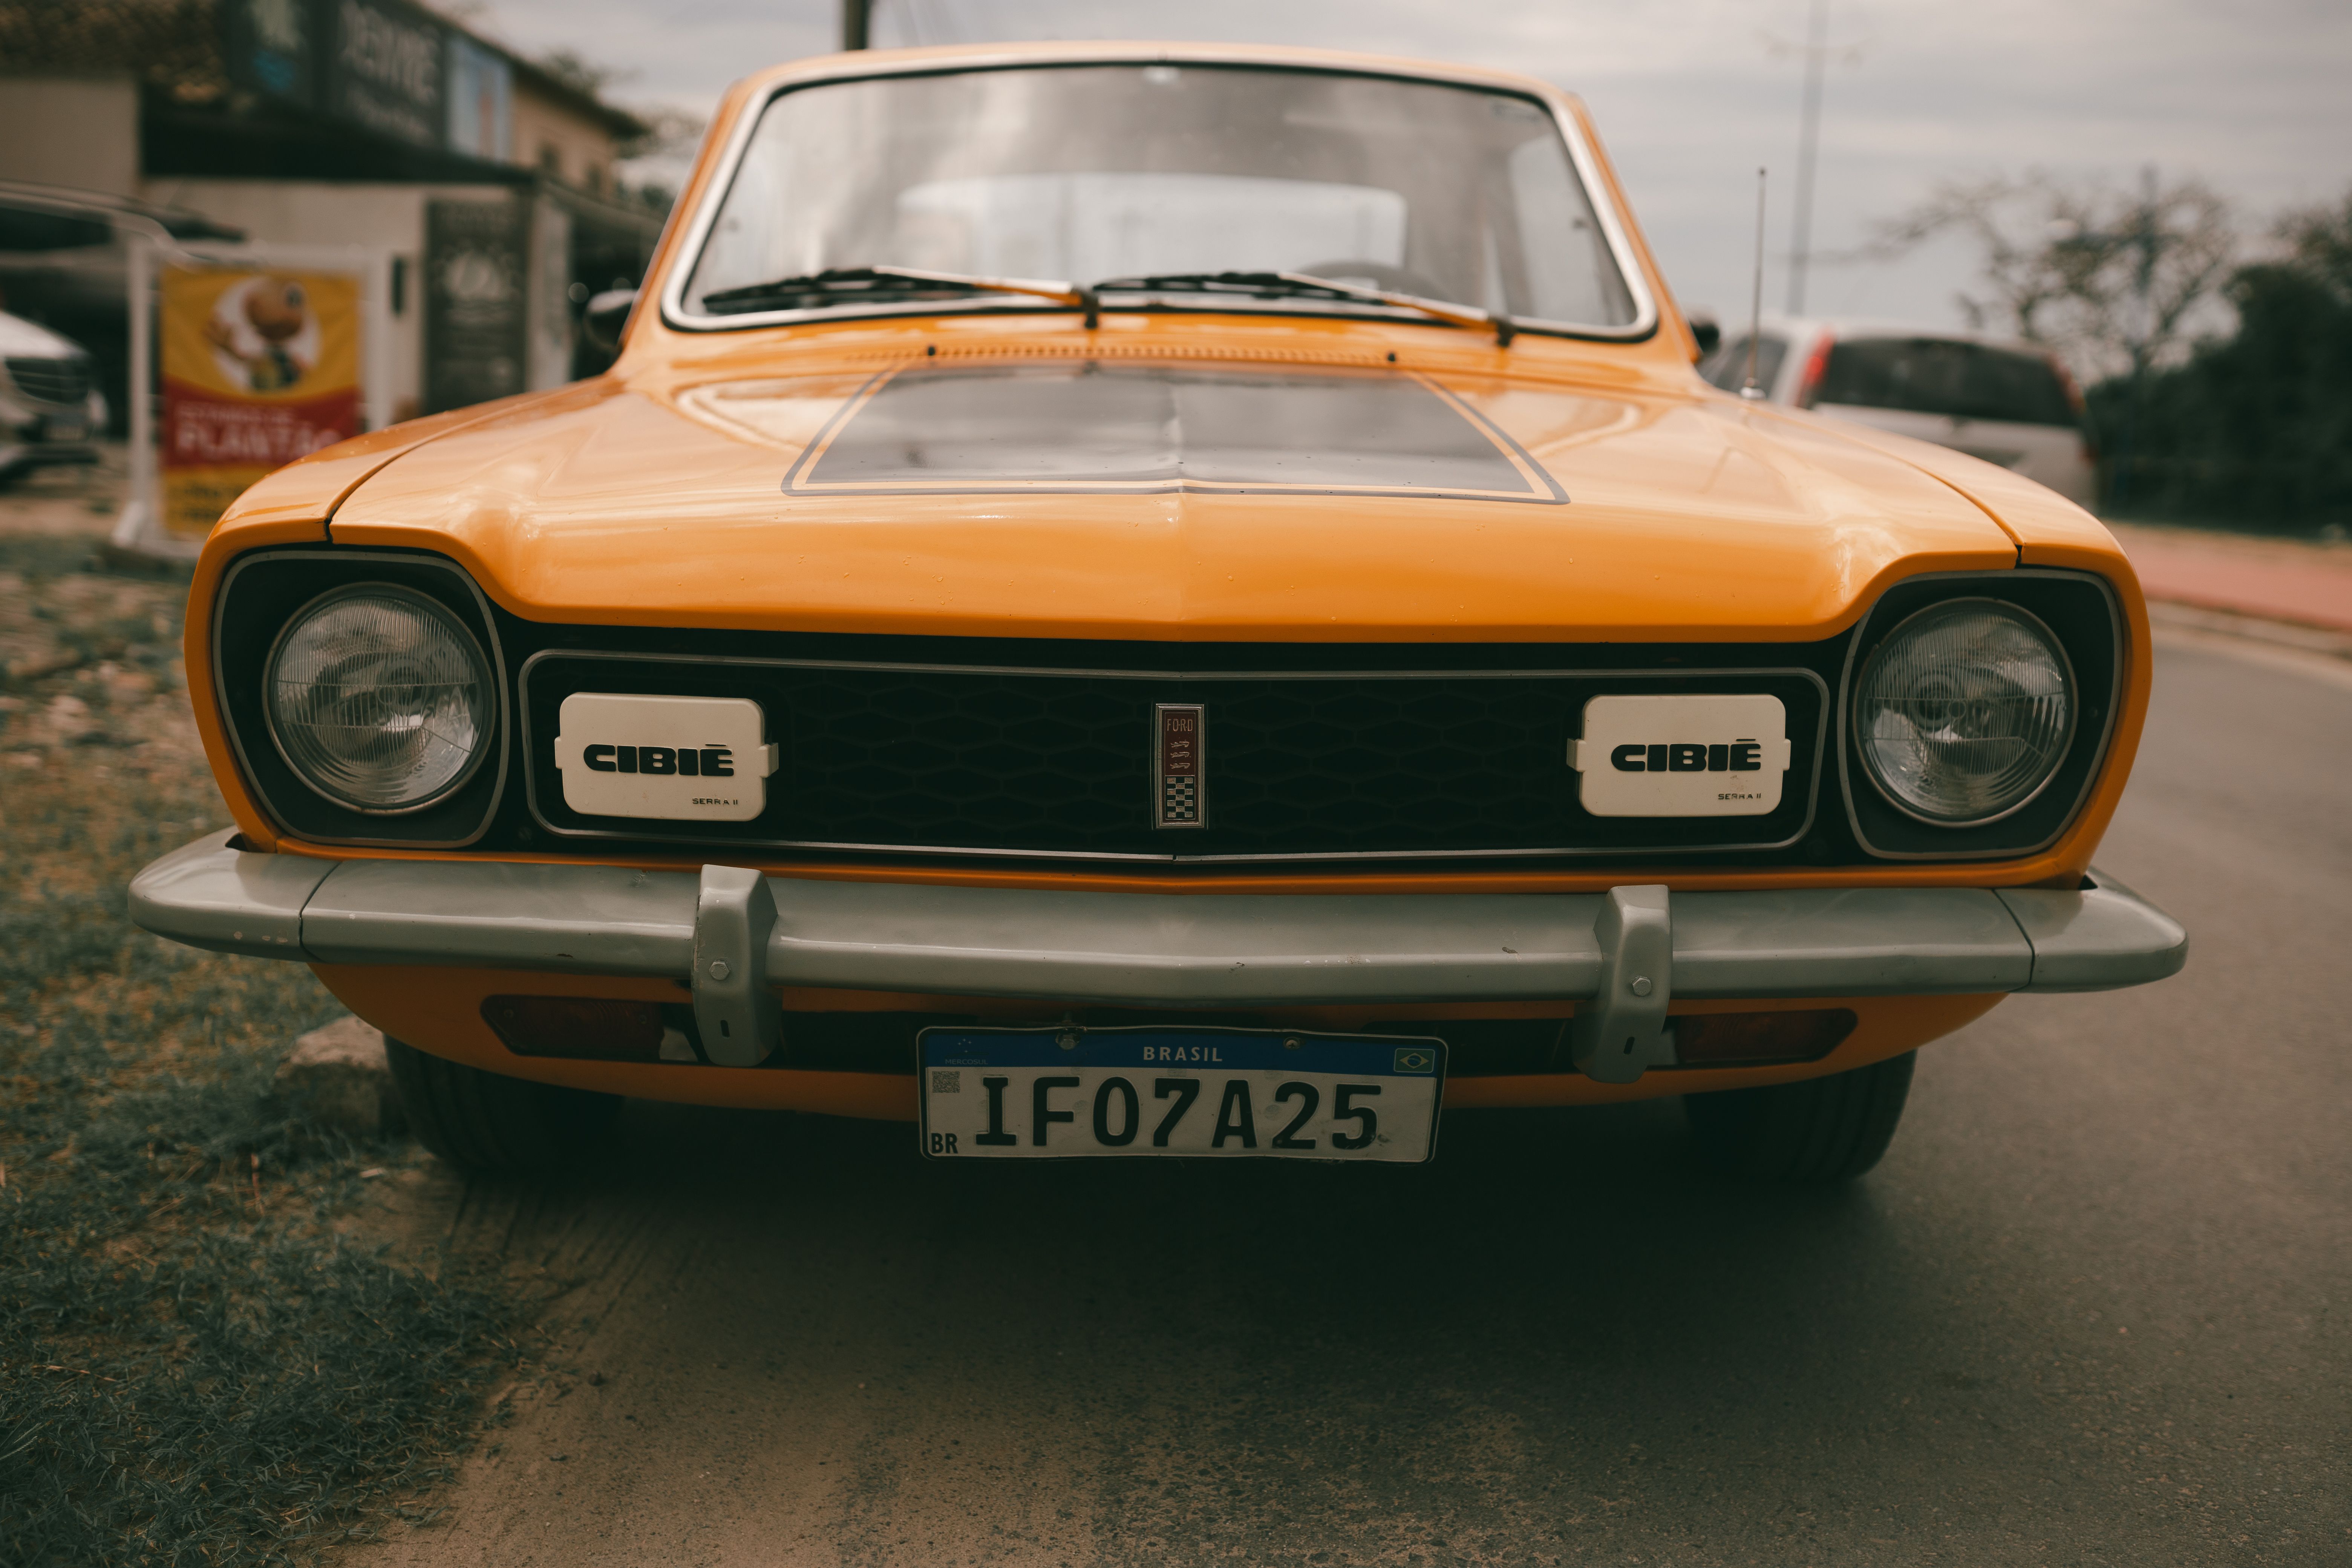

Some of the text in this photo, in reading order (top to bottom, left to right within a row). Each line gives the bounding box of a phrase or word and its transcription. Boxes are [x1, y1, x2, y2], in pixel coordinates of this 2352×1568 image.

[1167, 718, 1193, 732] FORD
[1143, 1046, 1223, 1062] BRASIL
[931, 1133, 958, 1154] BR
